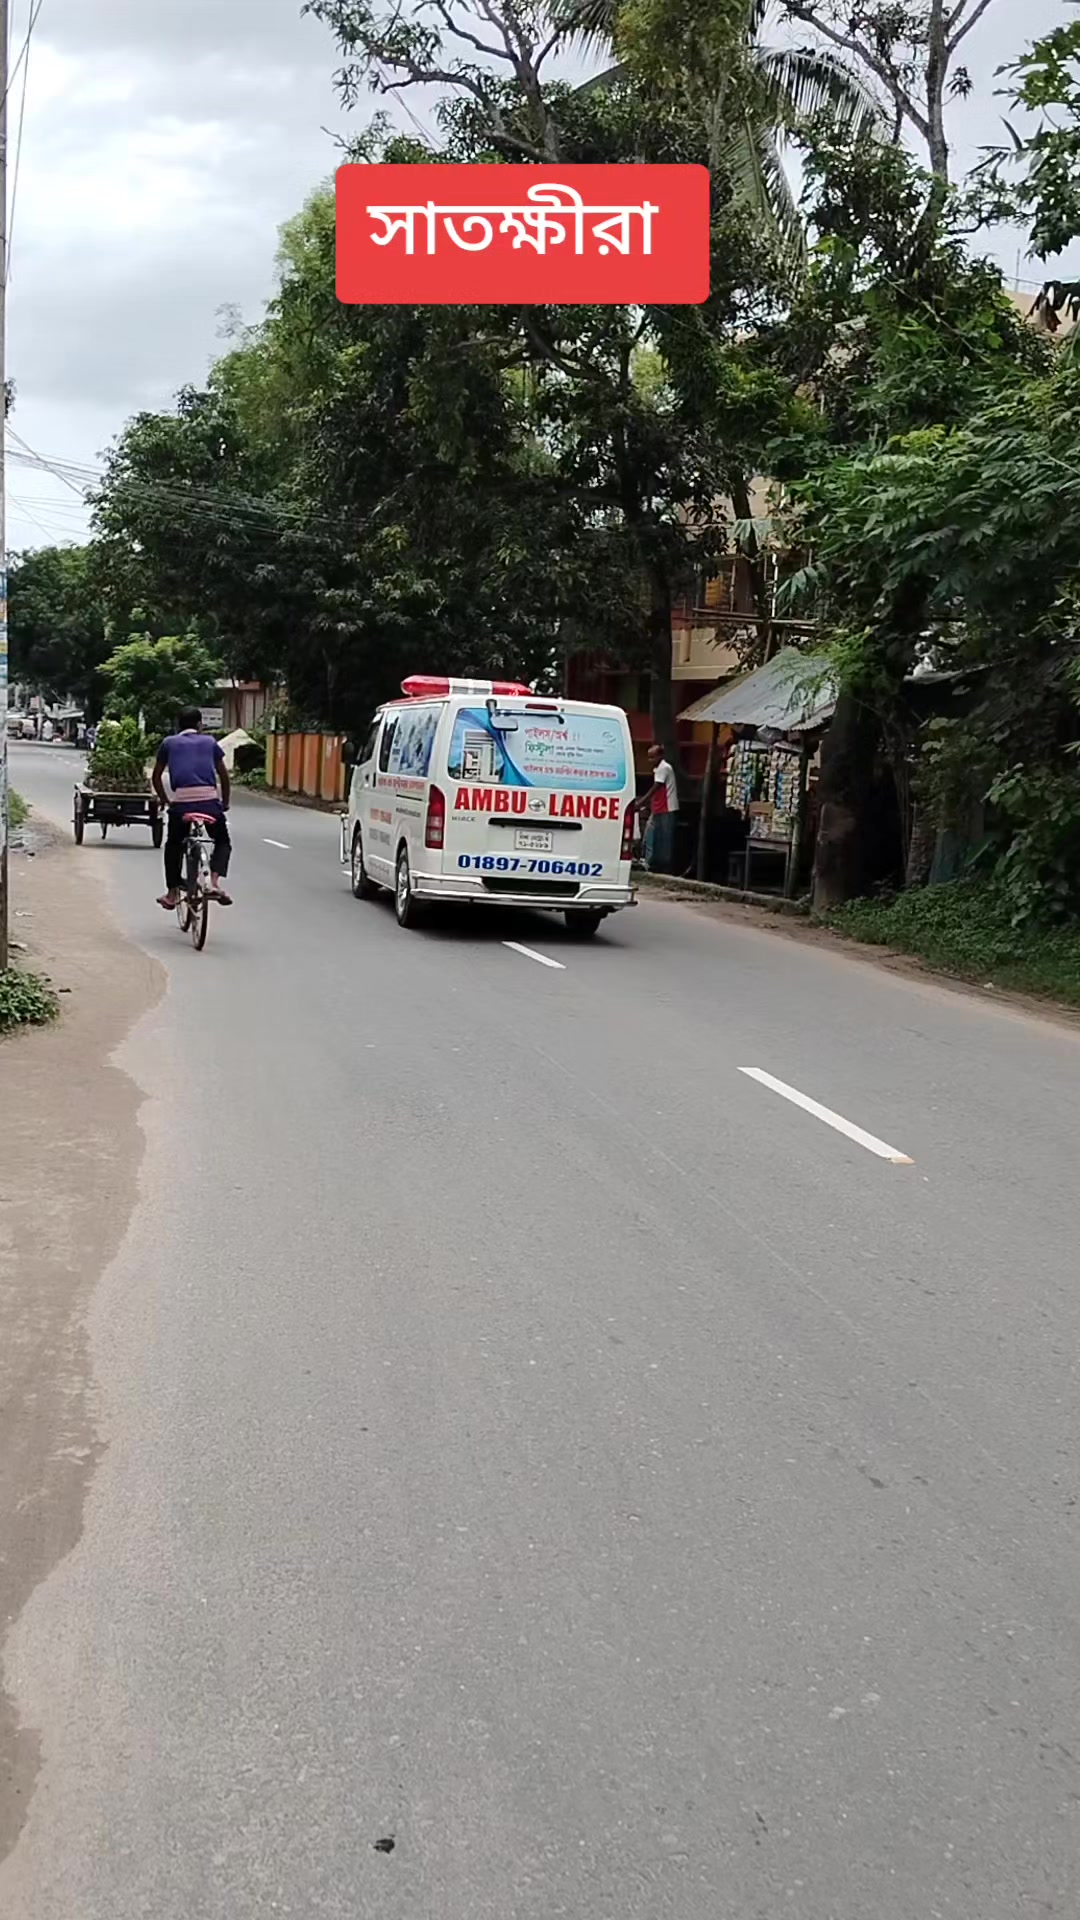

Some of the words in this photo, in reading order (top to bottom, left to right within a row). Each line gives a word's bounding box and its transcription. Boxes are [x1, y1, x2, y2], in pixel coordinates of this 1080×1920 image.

[454, 787, 527, 814] AMBU
[549, 793, 620, 820] LANCE
[458, 854, 603, 877] 01897-706402
